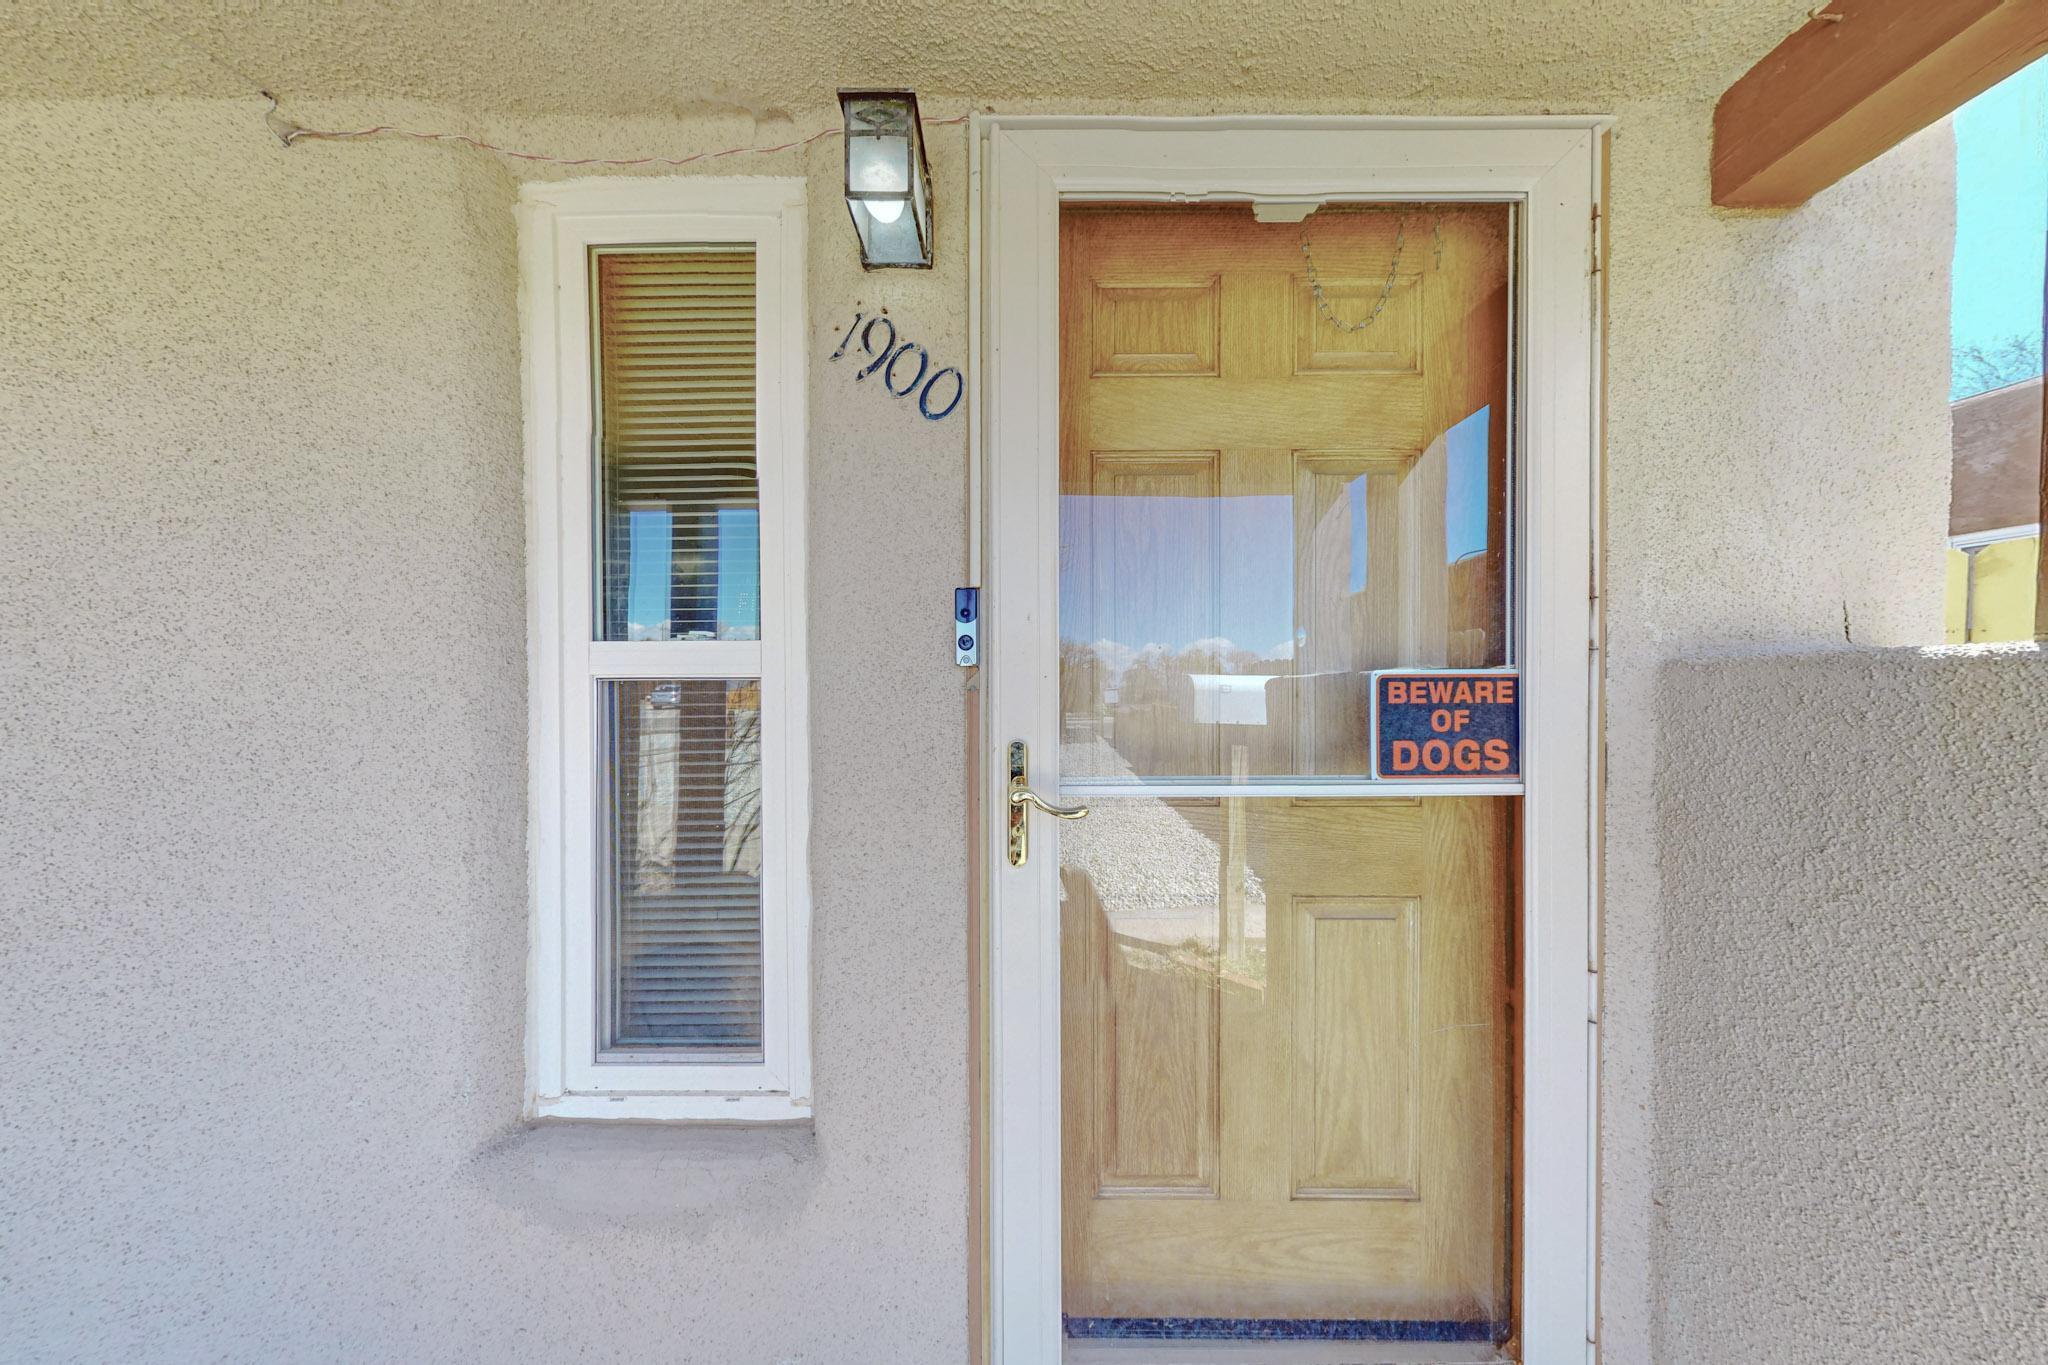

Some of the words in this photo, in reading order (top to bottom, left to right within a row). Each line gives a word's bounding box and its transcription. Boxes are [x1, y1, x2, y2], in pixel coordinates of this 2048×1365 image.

[829, 312, 964, 421] 1900
[1387, 680, 1514, 704] BEWARE
[1431, 709, 1470, 733] OF
[1391, 738, 1510, 772] DOGS
